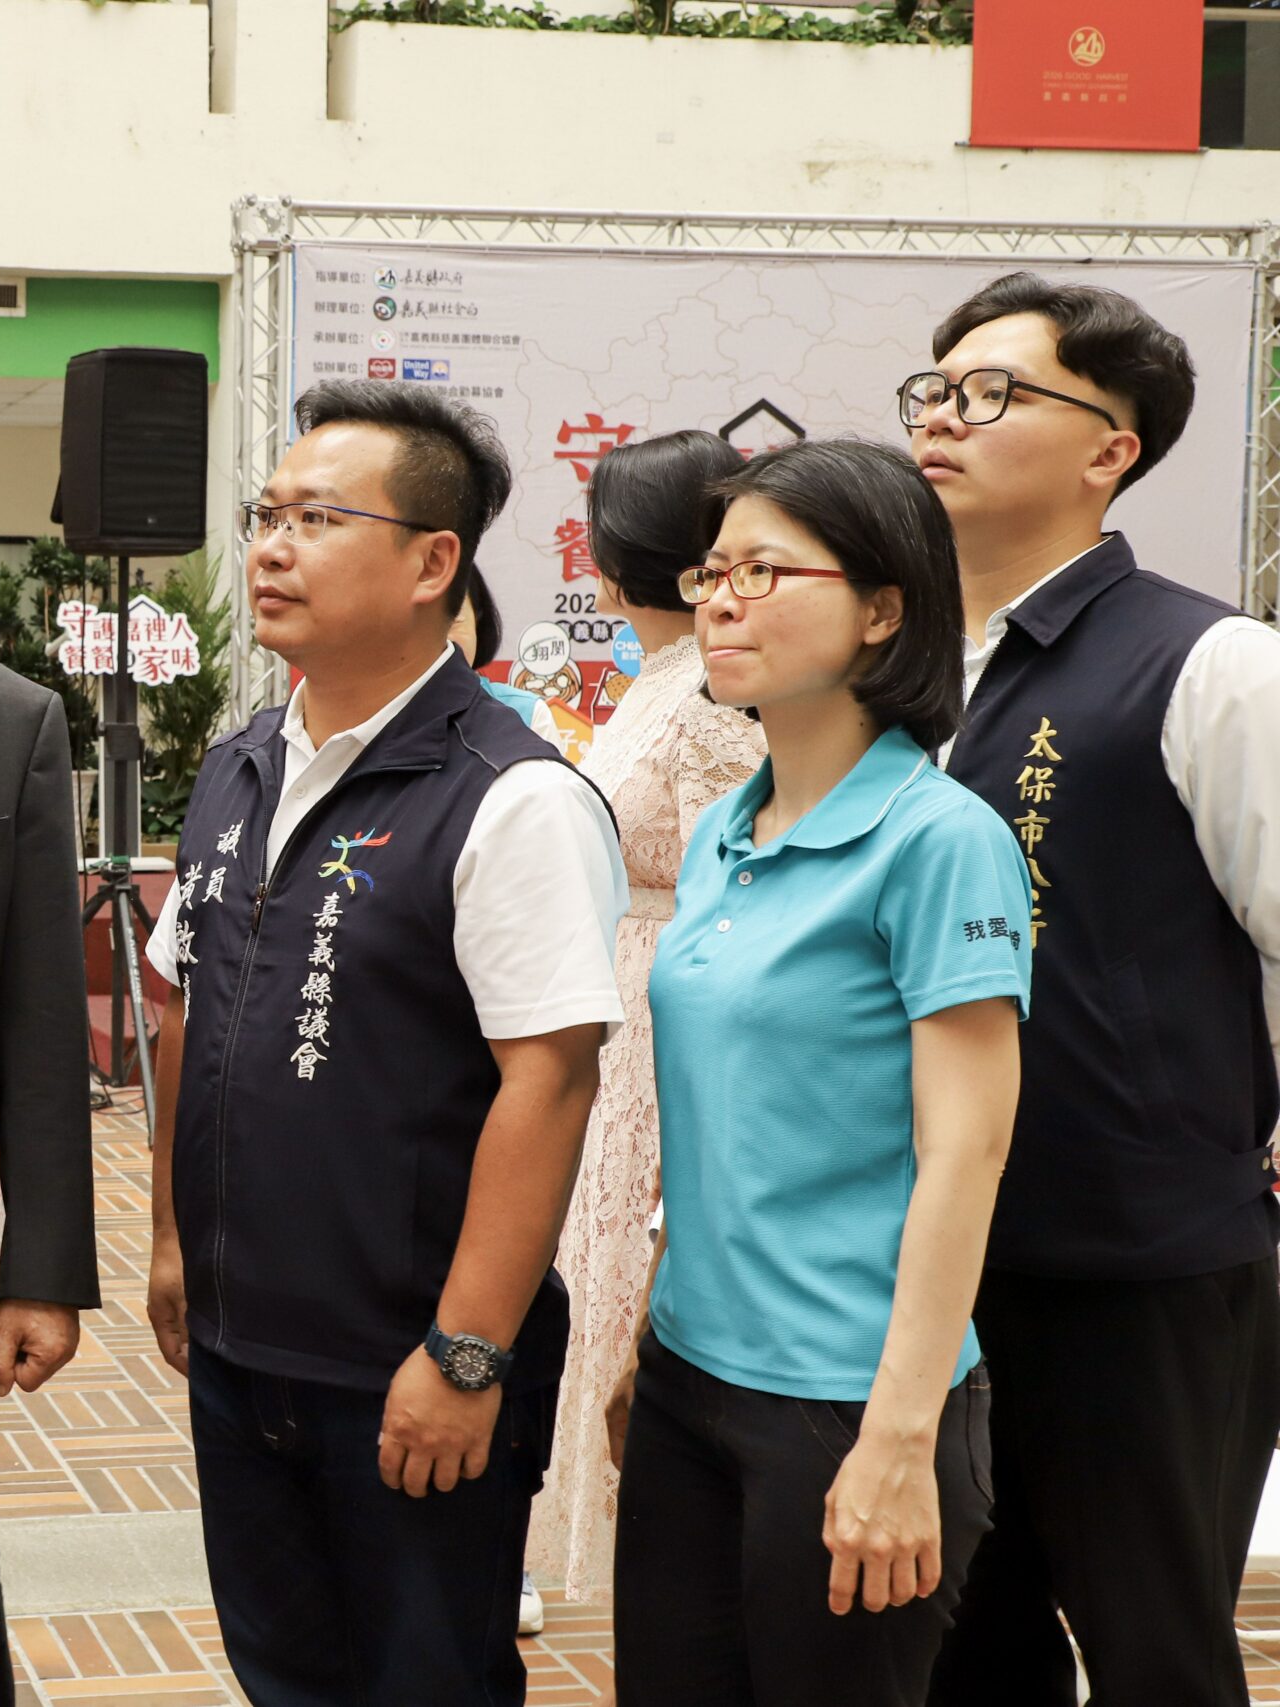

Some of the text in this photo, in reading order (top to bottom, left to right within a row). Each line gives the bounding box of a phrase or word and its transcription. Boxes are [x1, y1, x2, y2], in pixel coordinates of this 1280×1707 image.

[290, 892, 344, 1081] 嘉義縣議會
